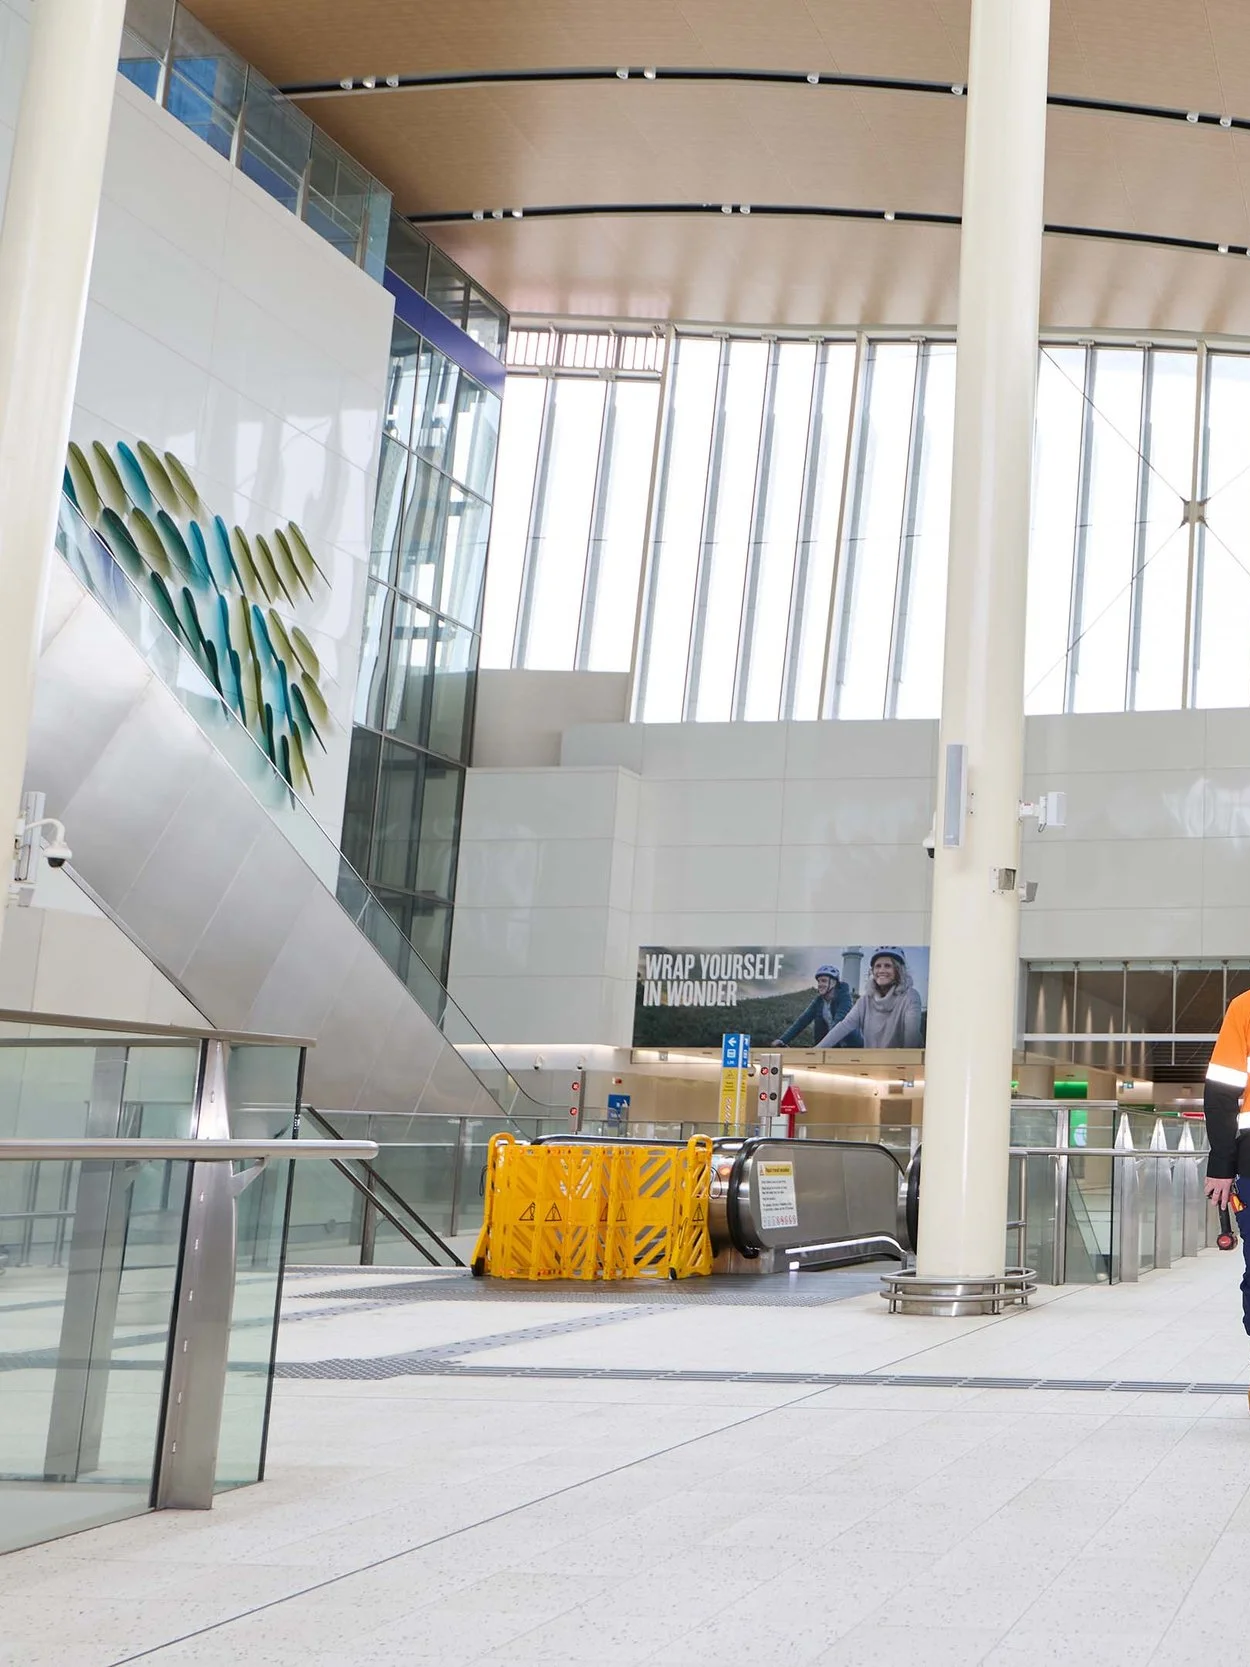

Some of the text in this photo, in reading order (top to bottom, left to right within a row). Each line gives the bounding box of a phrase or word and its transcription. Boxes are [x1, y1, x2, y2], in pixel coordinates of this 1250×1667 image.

[645, 953, 785, 980] WRAP YOURSELF
[642, 980, 738, 1007] IN WONDER
